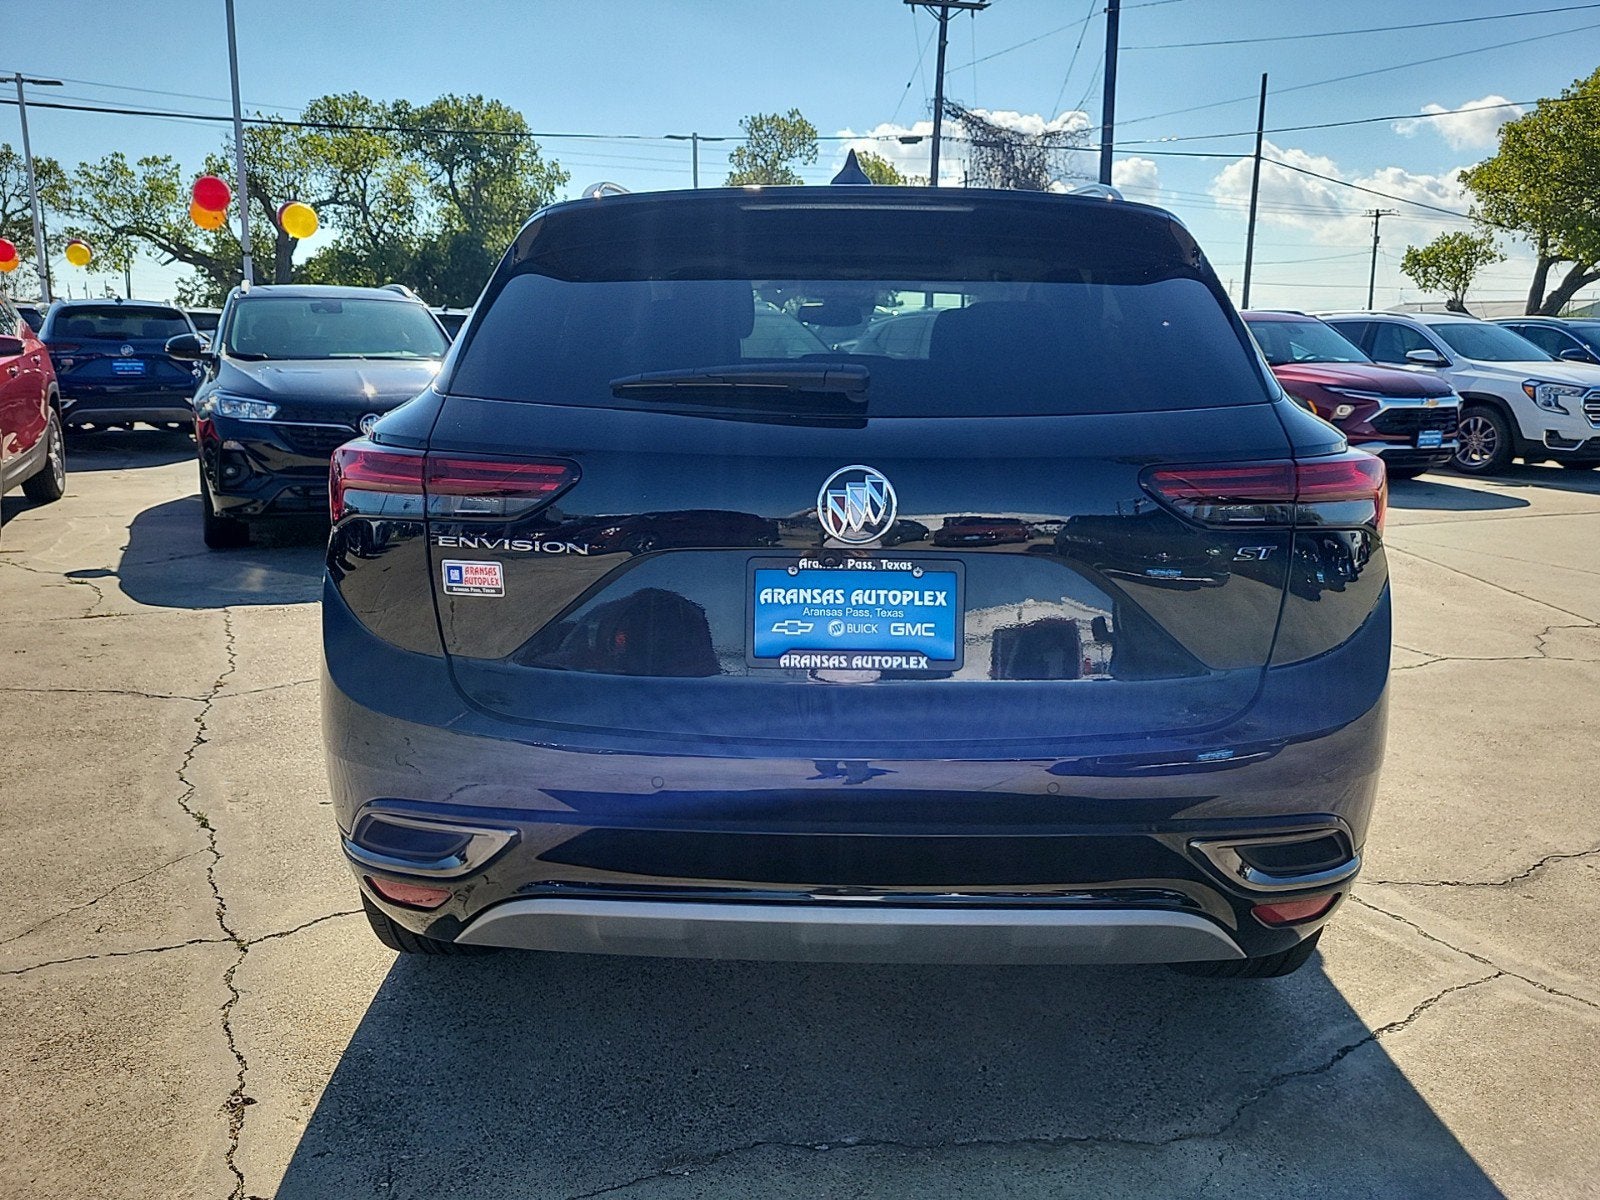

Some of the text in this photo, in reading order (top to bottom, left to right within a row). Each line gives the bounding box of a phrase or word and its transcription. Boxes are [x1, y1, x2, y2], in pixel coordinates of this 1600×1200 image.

[437, 535, 589, 556] ENVISION
[1232, 545, 1278, 561] ST
[464, 566, 497, 576] ARANSAS
[847, 559, 876, 571] Pass,
[880, 559, 912, 570] Texas
[464, 576, 500, 586] AUTOPLEX
[759, 588, 948, 607] ARANSAS AUTOPLEX
[802, 607, 904, 618] Aransas Pass, Texas
[846, 623, 878, 634] BUICK
[890, 622, 935, 637] GMC
[779, 654, 928, 669] ARANSAS AUTOPLEX
